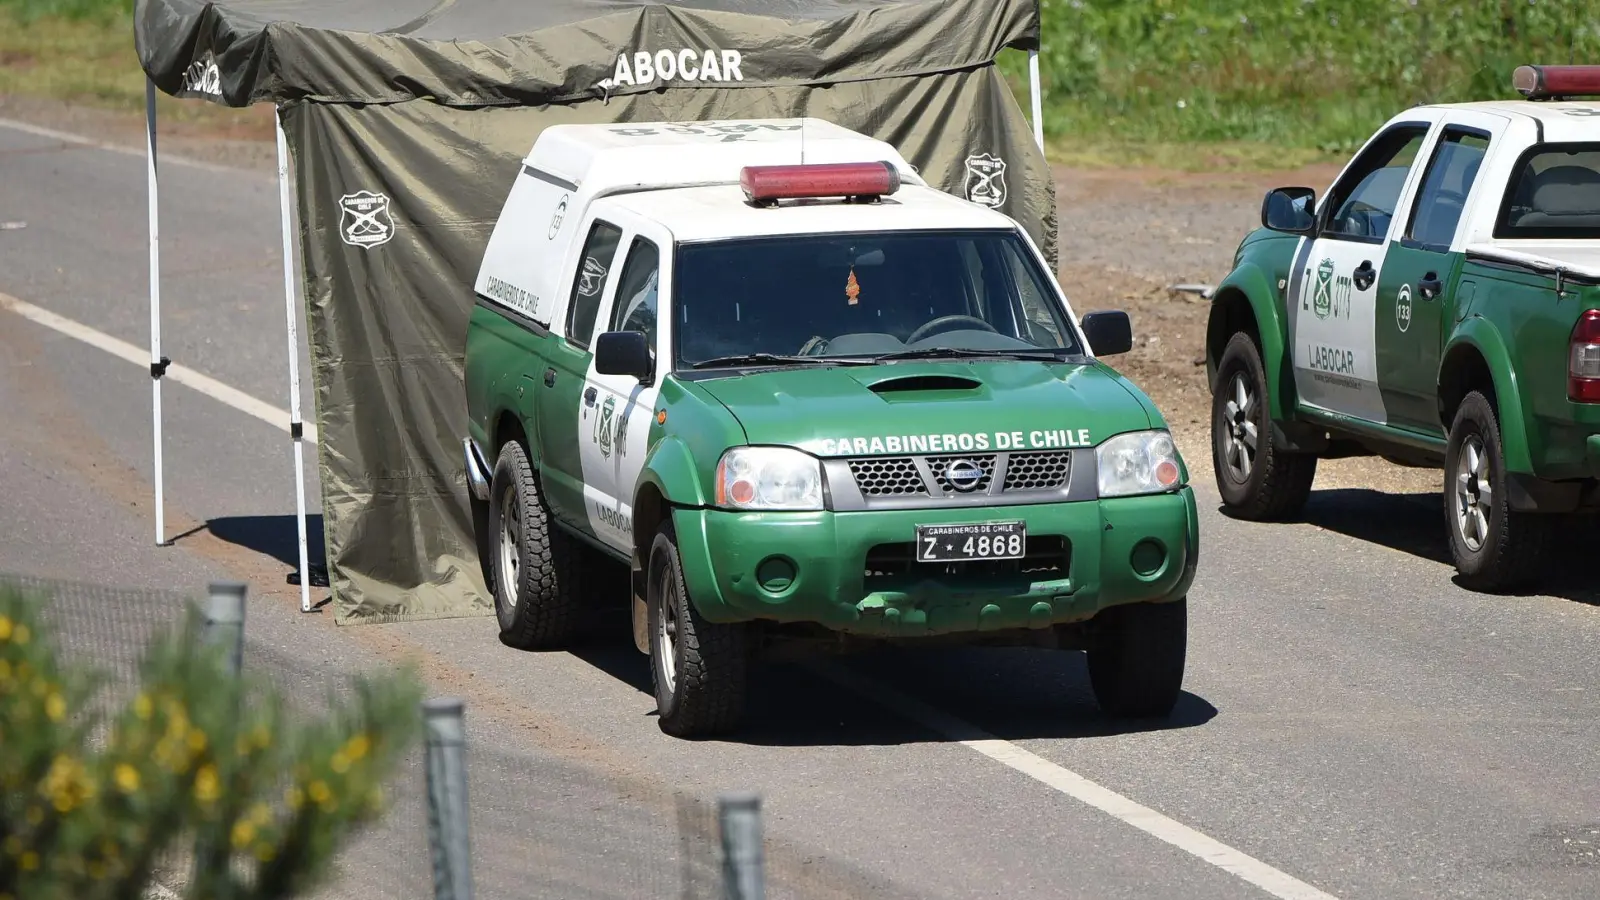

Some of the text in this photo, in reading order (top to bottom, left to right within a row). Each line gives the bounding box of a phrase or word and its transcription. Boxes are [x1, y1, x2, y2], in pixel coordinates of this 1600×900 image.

[1303, 268, 1311, 311] Z
[1397, 304, 1410, 320] 133
[1308, 344, 1354, 374] LABOCAR
[821, 429, 1092, 455] CARABINEROS DE CHILE
[950, 470, 979, 478] NISSAN
[928, 525, 1014, 535] CARABINEROS DE CHILE
[923, 534, 1021, 559] Z 4868
